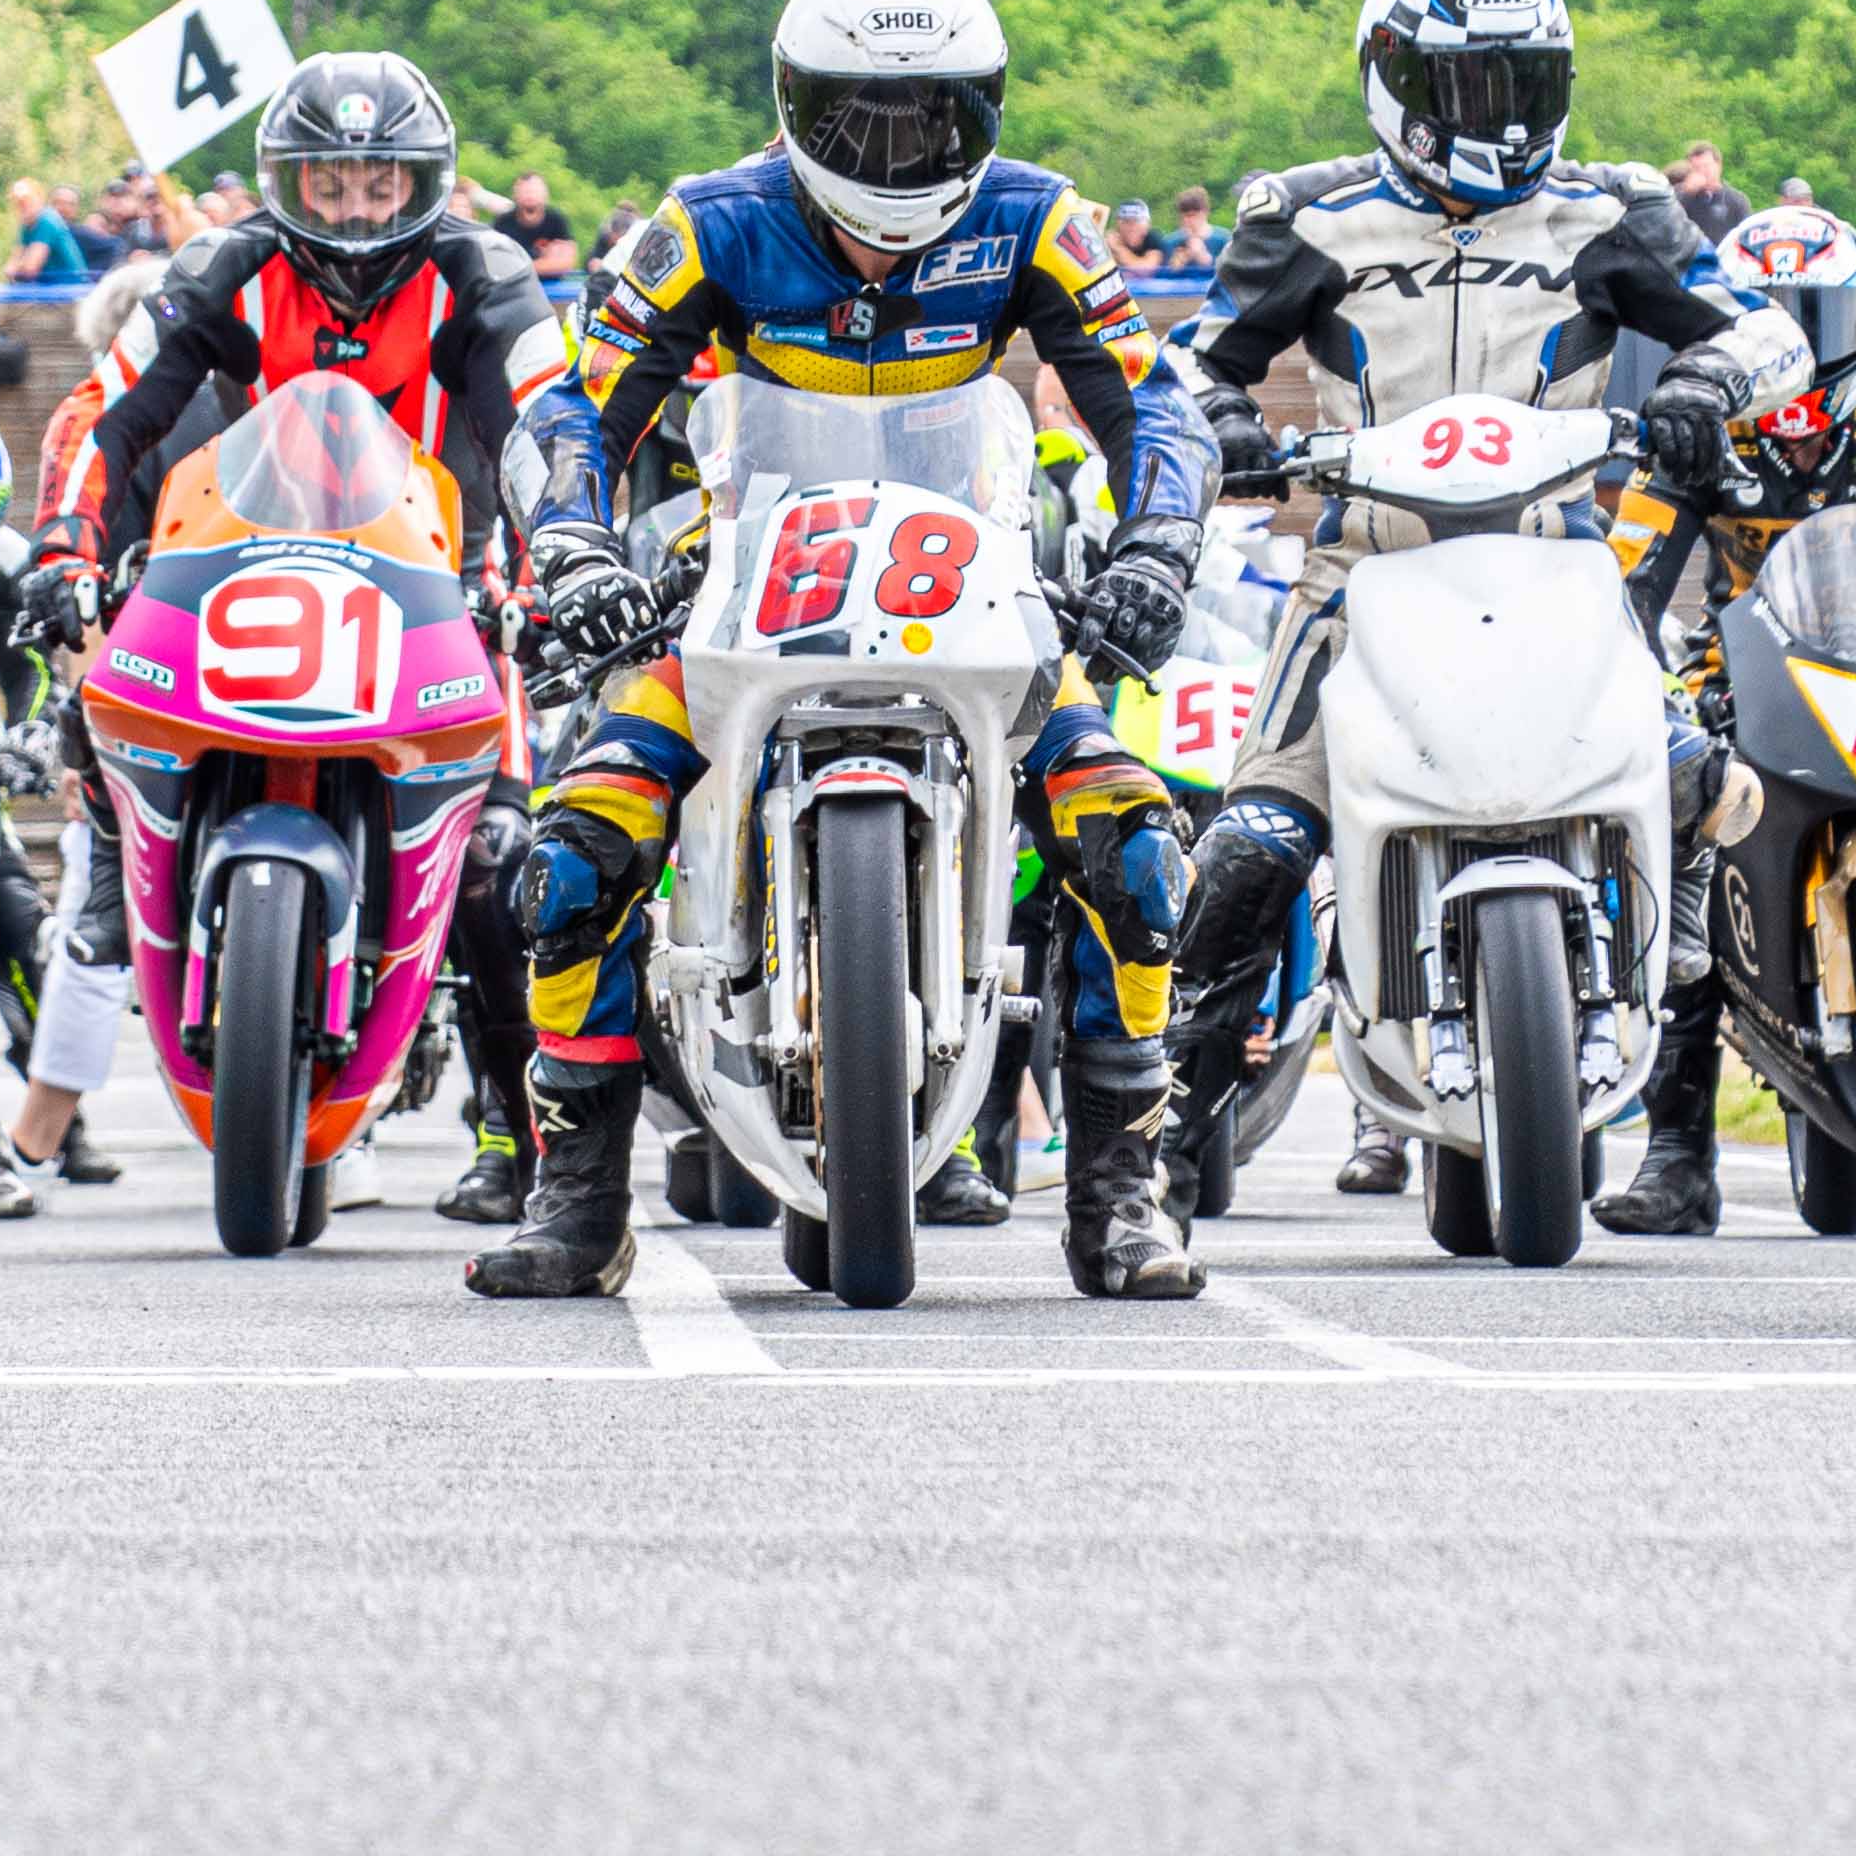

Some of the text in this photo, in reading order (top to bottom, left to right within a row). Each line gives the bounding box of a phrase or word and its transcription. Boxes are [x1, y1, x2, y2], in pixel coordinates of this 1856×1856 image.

[872, 12, 933, 30] SHOEI
[175, 9, 240, 110] 4
[918, 236, 1015, 284] FFM
[1346, 255, 1576, 298] IXON
[1420, 415, 1513, 470] 93
[755, 496, 979, 637] 68
[202, 575, 382, 714] 91
